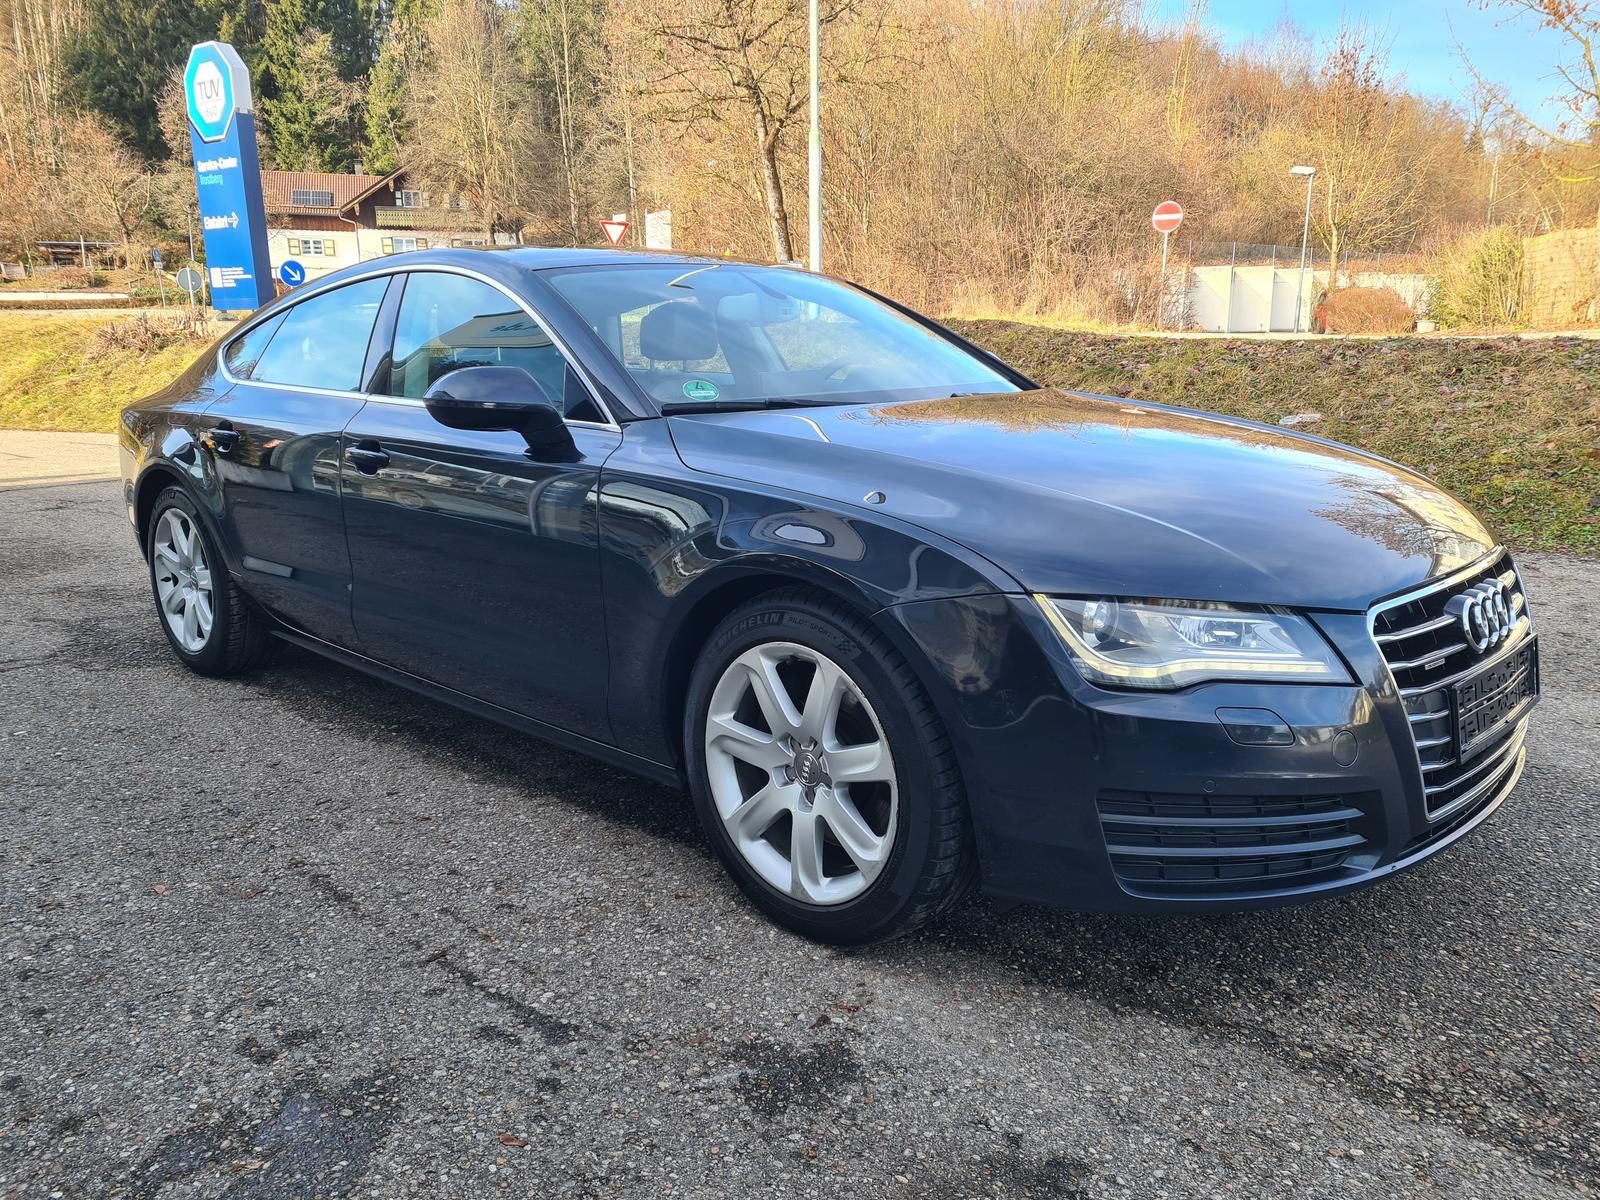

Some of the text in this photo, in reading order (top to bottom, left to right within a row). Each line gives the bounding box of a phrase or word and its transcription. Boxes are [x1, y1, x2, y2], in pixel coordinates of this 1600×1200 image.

[717, 612, 781, 648] MICHELIN
[788, 616, 832, 638] PILOT SPORT
